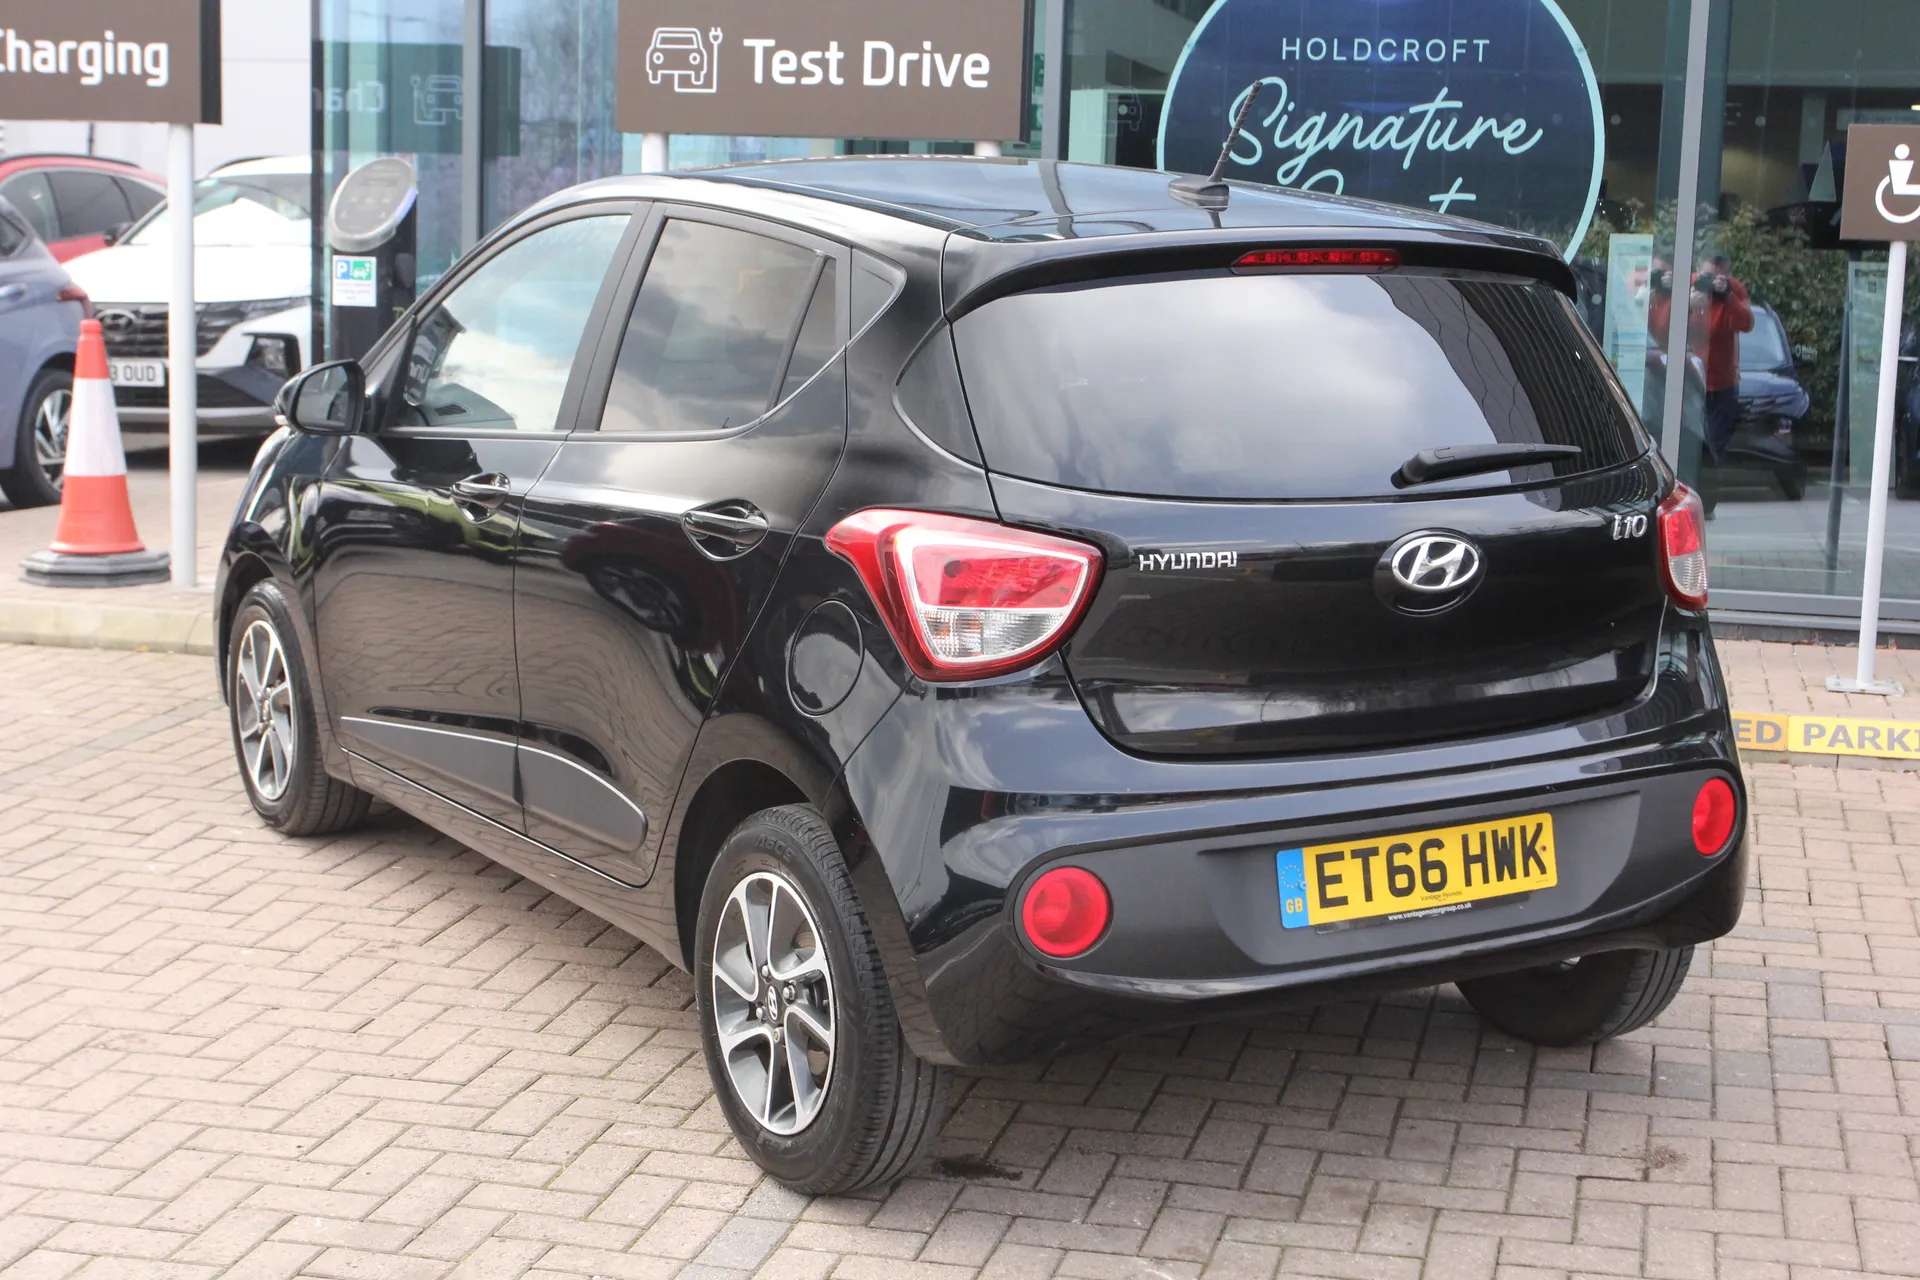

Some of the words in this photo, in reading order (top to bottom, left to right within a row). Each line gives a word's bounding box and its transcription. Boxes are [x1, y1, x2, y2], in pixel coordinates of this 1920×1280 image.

[0, 28, 169, 87] harging
[743, 38, 845, 85] Test
[863, 40, 990, 88] Drive
[1281, 37, 1490, 62] HOLDCROFT
[1229, 76, 1543, 185] Signature
[123, 365, 156, 382] OUD
[1613, 514, 1648, 541] i10
[1139, 551, 1237, 571] HYUNDAI
[1315, 838, 1448, 909] ET66
[1461, 822, 1547, 888] HWK
[1286, 897, 1303, 913] GB
